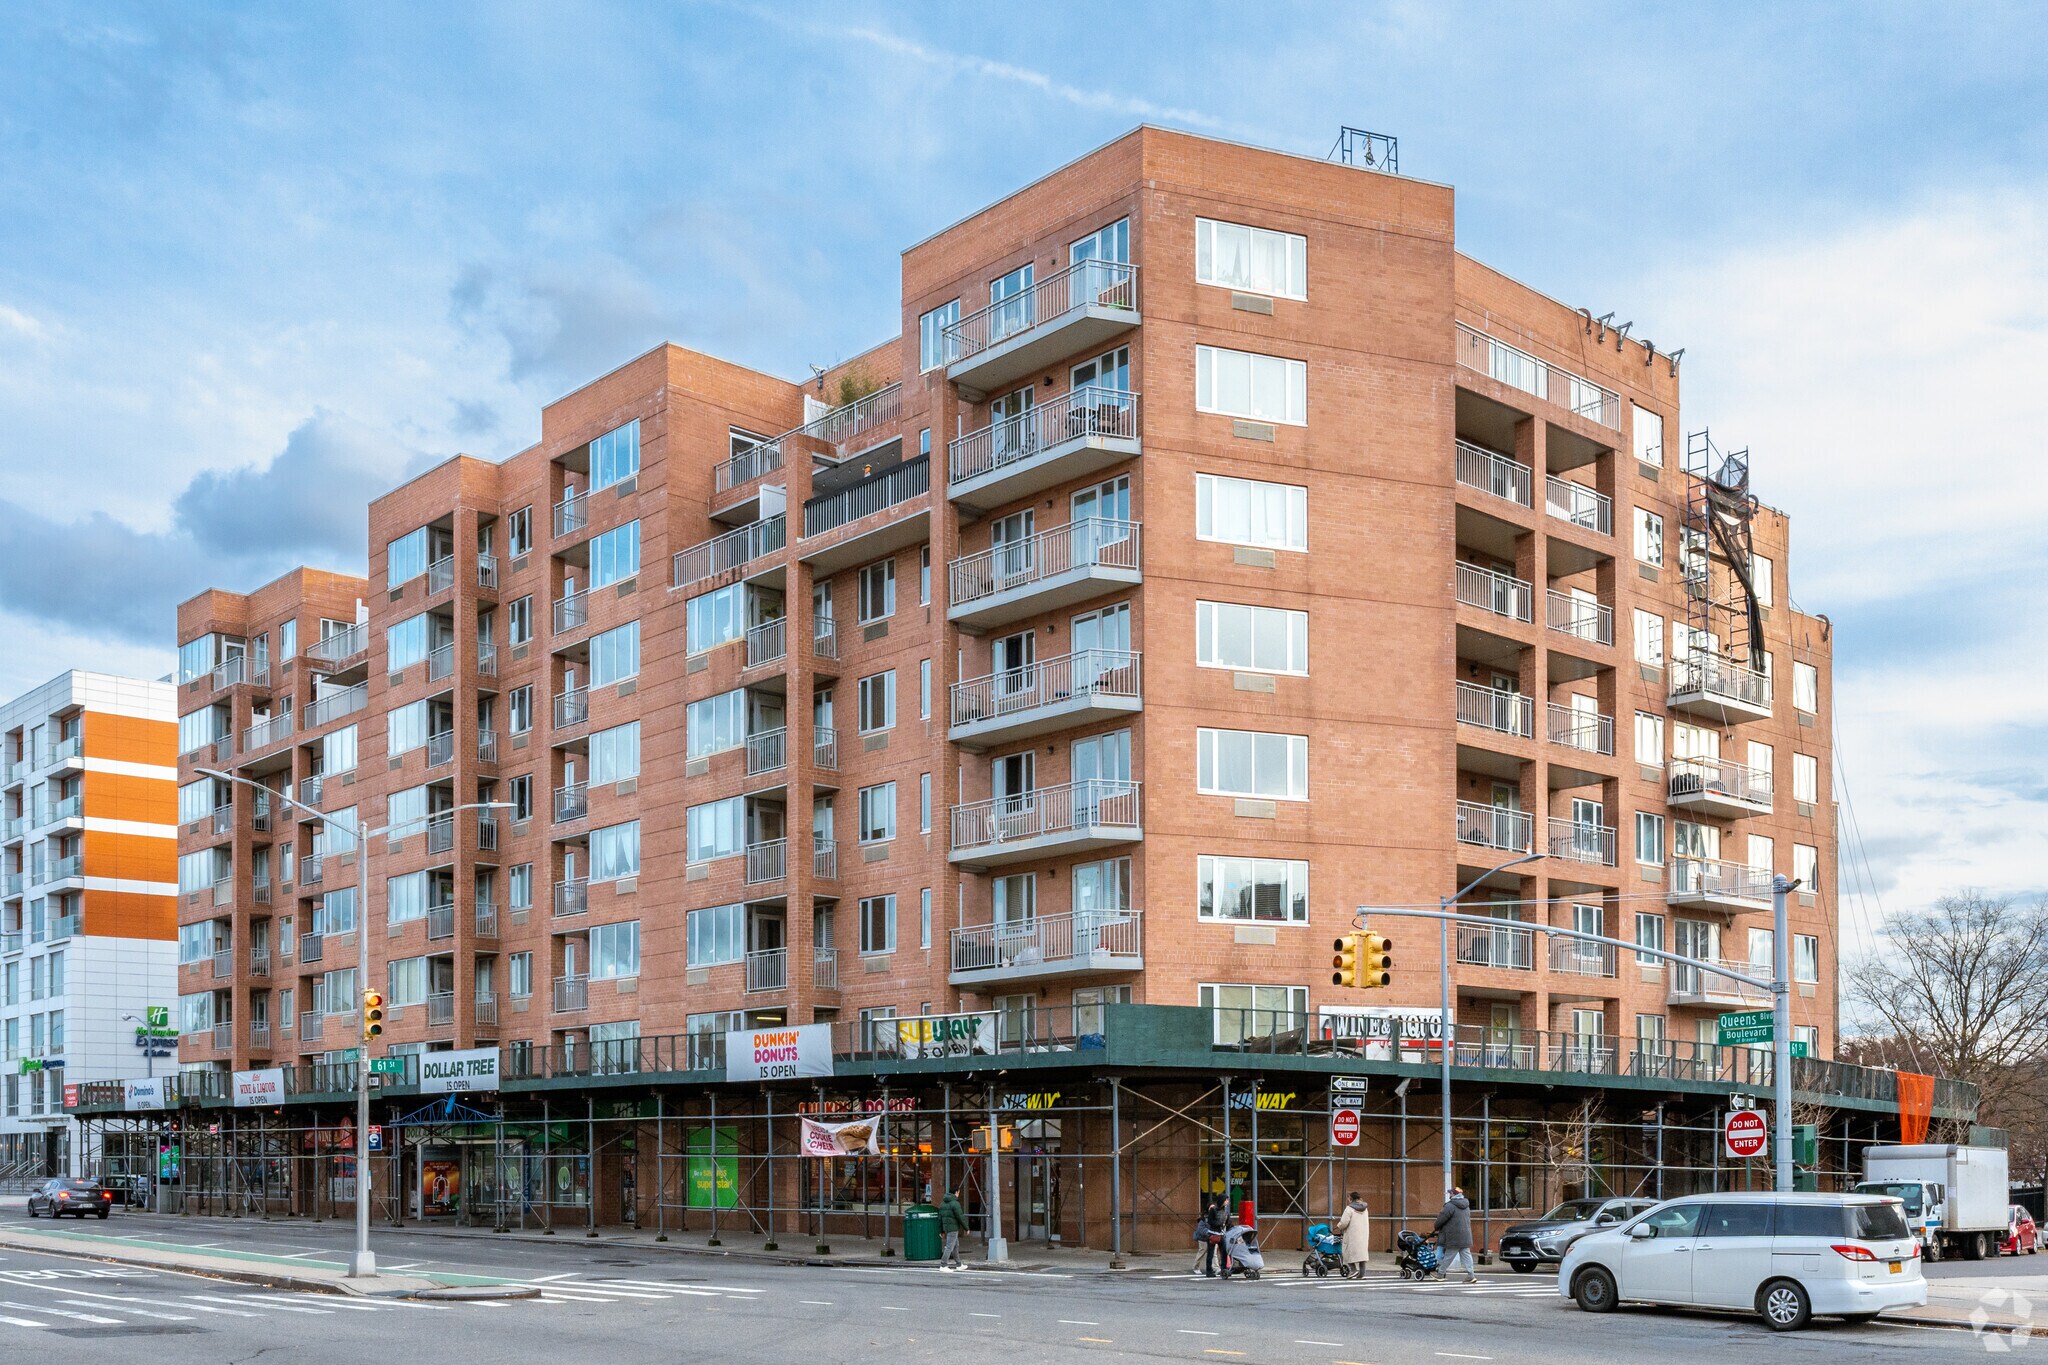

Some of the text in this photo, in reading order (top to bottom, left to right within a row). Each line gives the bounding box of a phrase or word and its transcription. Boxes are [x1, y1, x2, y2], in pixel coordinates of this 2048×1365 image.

[1399, 1014, 1453, 1039] IQUO
[1720, 1015, 1757, 1029] Queens
[135, 1027, 166, 1038] Hoday
[900, 1018, 982, 1043] SUBWAY
[1726, 1028, 1767, 1039] Boulevard
[754, 1031, 799, 1048] DUNKIN'
[1791, 1043, 1798, 1055] 61
[377, 1061, 387, 1071] 61
[424, 1058, 495, 1079] DOLLAR TREE
[760, 1065, 796, 1078] IS OPEN
[134, 1085, 154, 1096] Domino's
[446, 1080, 470, 1090] IS OPEN
[255, 1096, 268, 1104] OPEN
[1223, 1092, 1296, 1110] SUBWAY
[1732, 1120, 1758, 1129] DO NOT
[810, 1141, 835, 1151] CHEER
[1734, 1139, 1758, 1148] ENTER
[1220, 1151, 1249, 1164] SRIES
[702, 1170, 727, 1179] savngs
[697, 1179, 733, 1191] supestar!
